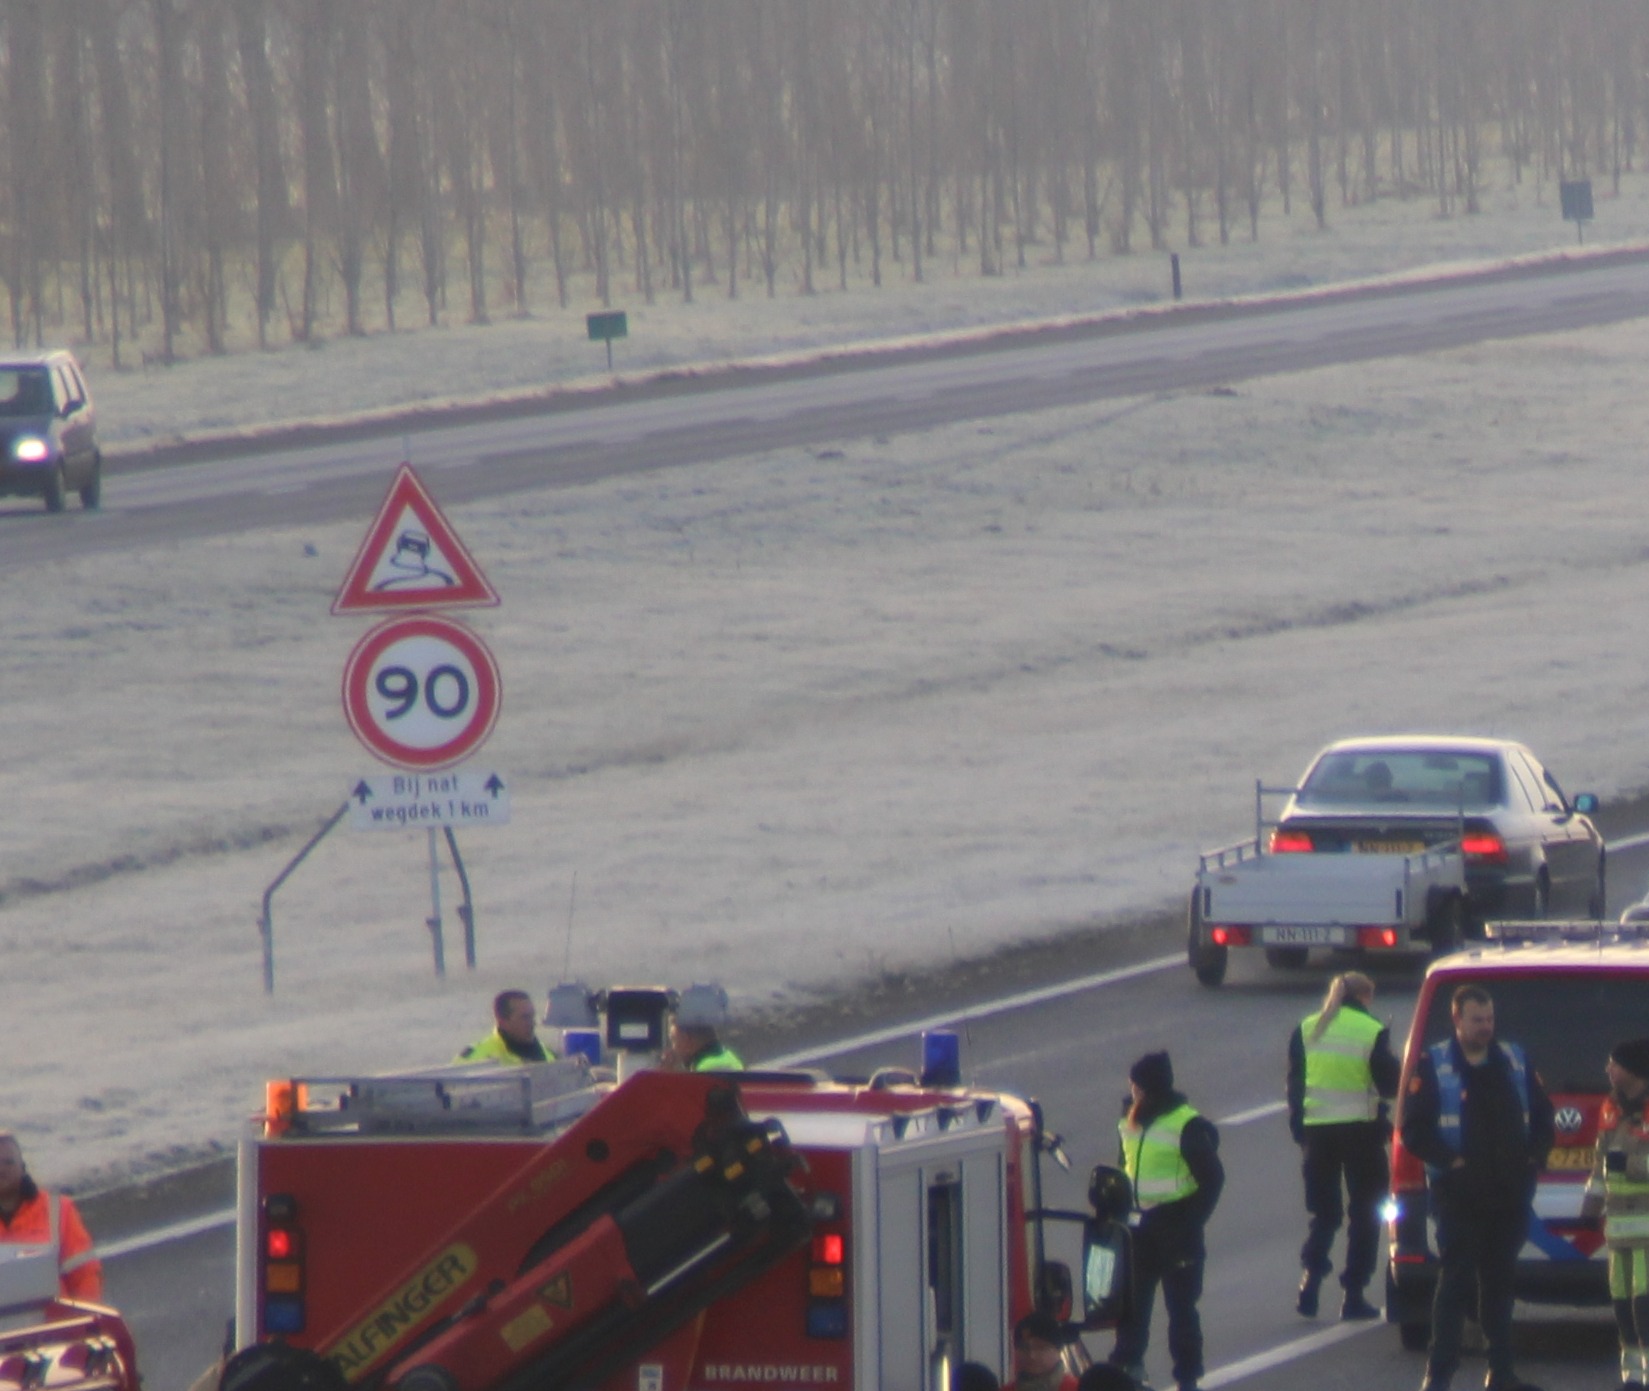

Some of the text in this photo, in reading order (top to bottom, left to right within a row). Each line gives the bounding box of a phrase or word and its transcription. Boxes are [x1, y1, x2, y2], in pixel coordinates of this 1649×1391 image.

[375, 664, 469, 720] 90
[394, 774, 458, 798] Bij nat
[371, 800, 442, 826] wegdek
[461, 799, 489, 817] km
[334, 1253, 469, 1371] ALFINGER
[704, 1364, 838, 1382] BRANDWEER
